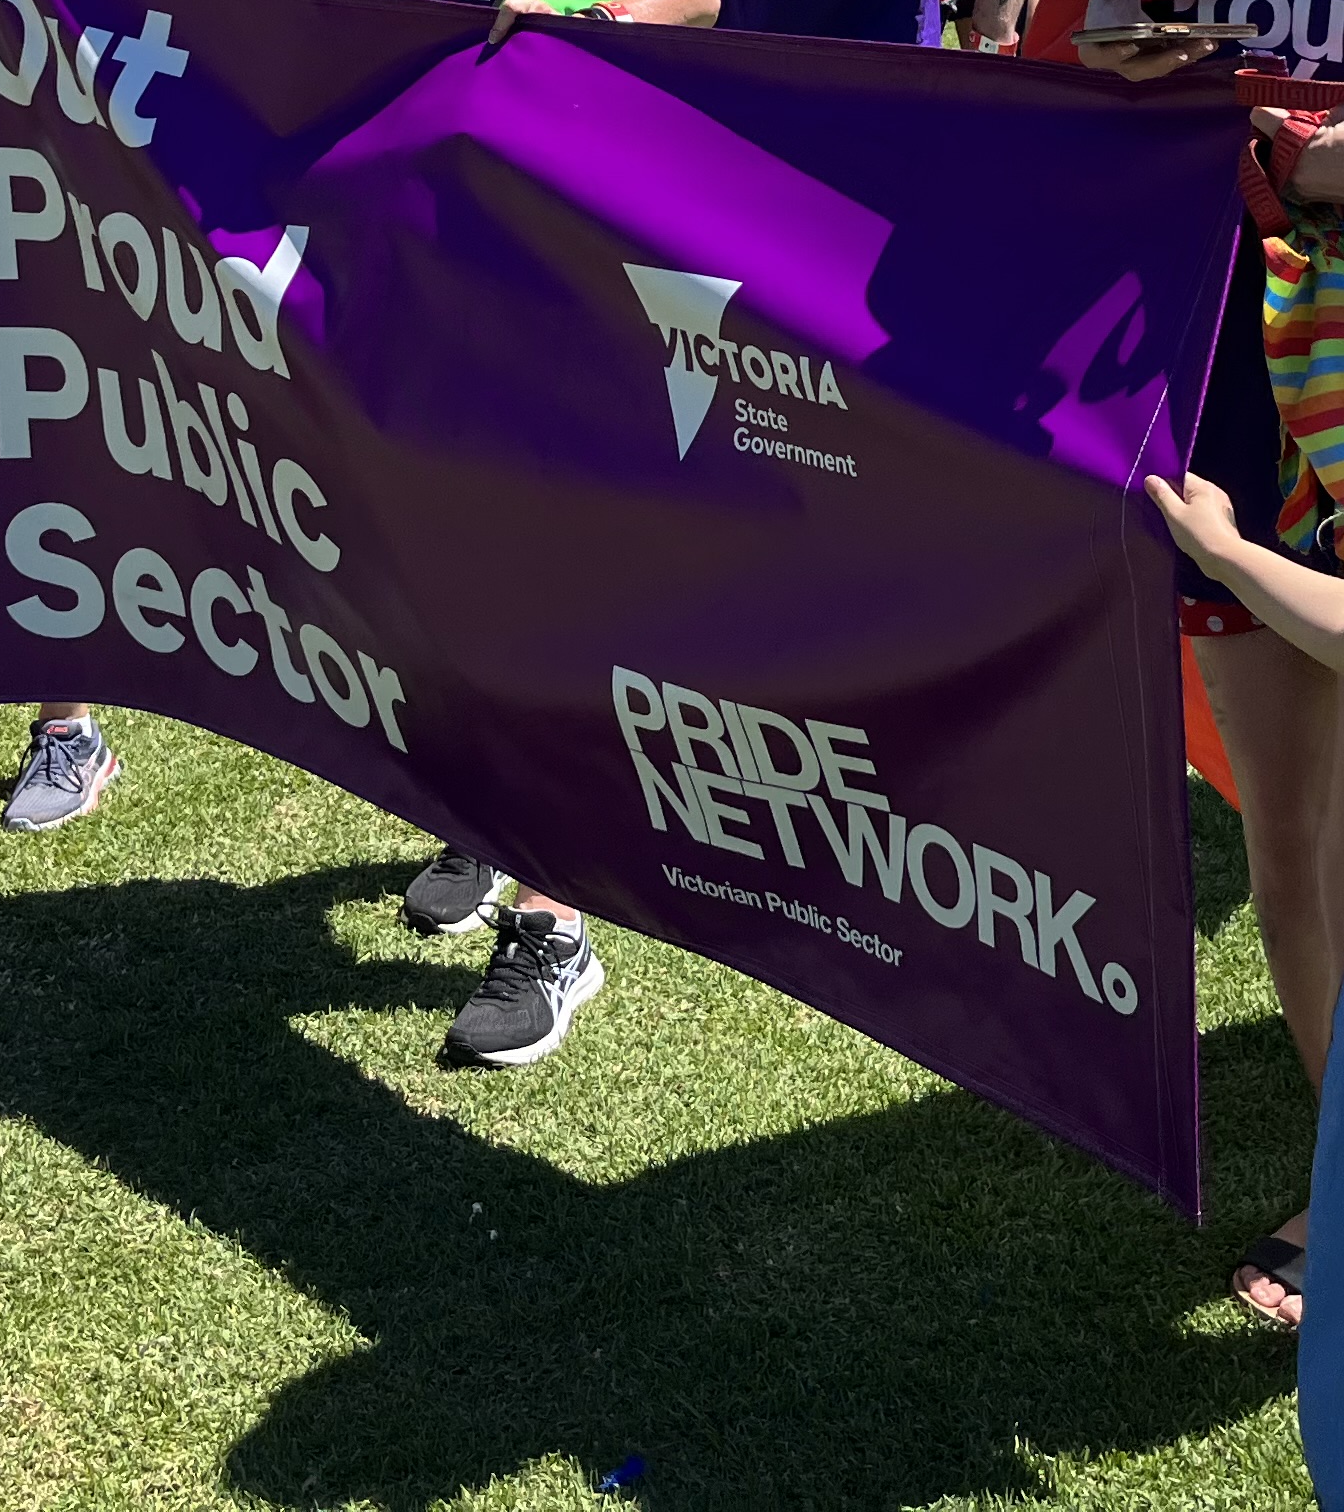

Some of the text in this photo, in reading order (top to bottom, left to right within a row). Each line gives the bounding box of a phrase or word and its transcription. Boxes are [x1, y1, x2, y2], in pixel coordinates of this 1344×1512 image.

[659, 325, 849, 411] VICTORIA
[734, 398, 788, 432] State
[733, 426, 858, 478] Government
[4, 501, 409, 755] Sector
[612, 664, 891, 813] PRIDE
[661, 863, 903, 967] Victorian Public Sector
